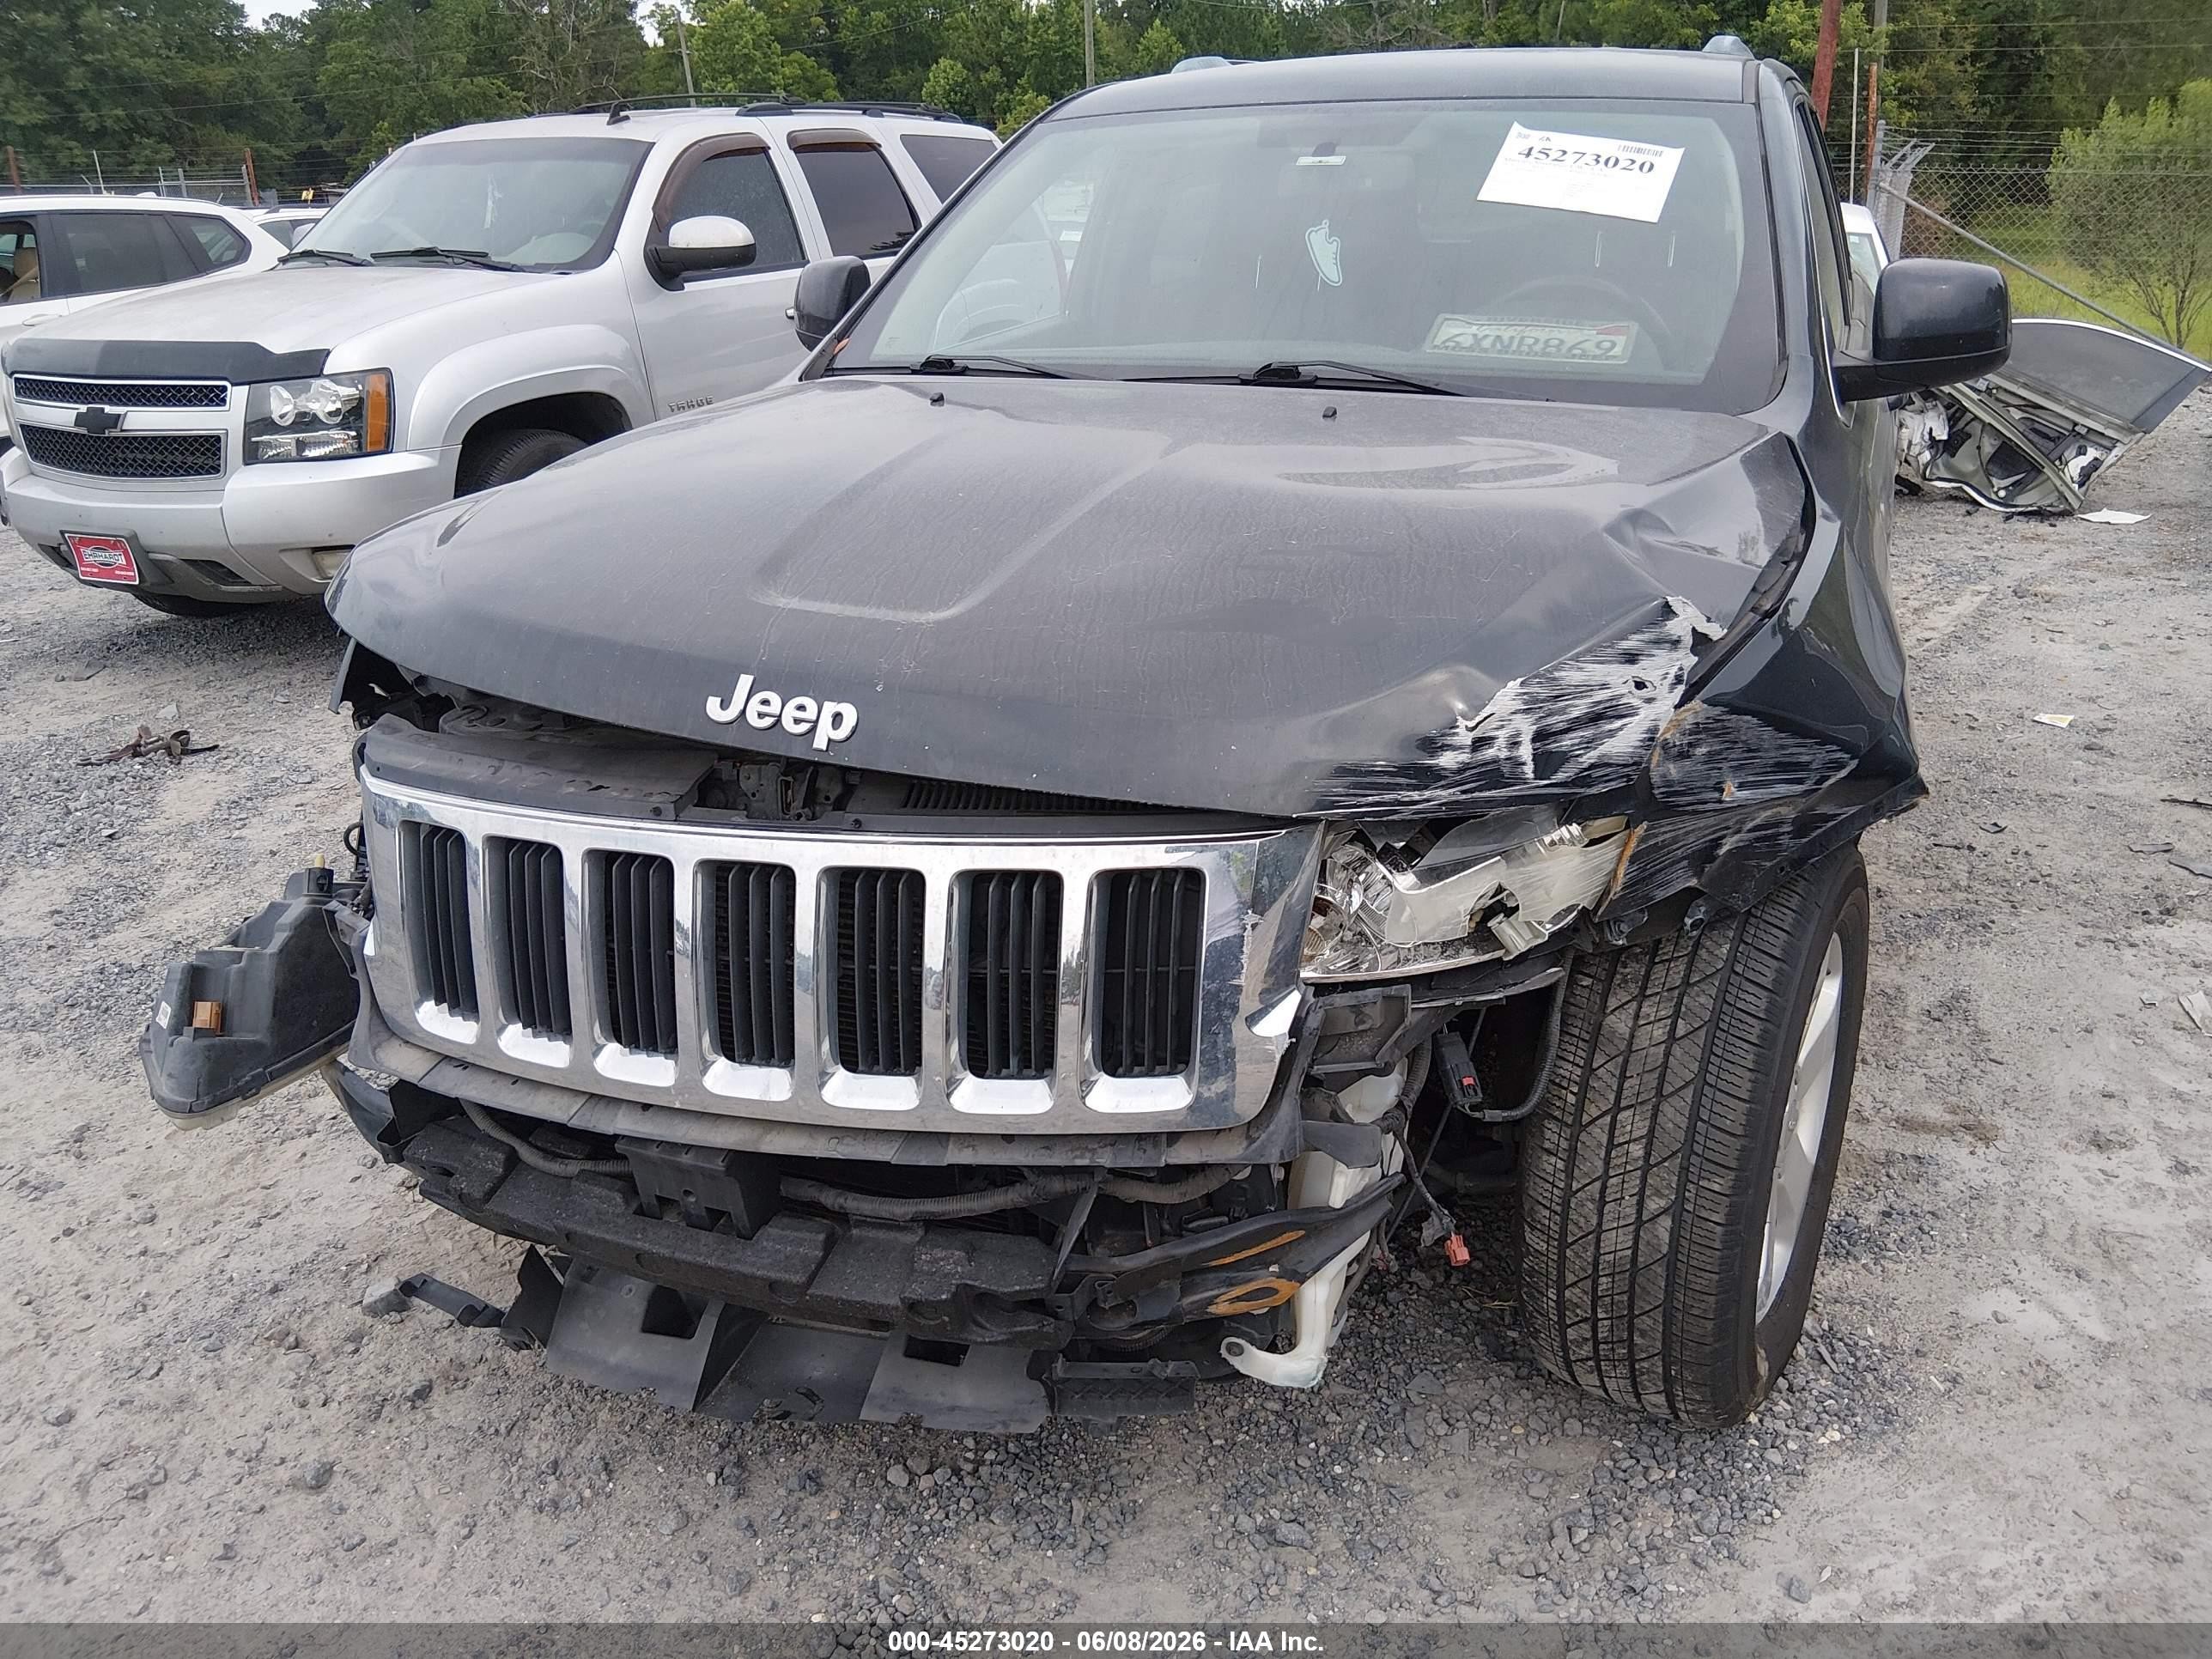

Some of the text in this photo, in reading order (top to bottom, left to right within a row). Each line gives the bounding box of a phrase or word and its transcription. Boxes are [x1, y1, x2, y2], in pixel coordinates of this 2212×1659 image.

[1517, 145, 1656, 174] 45273020
[1440, 332, 1618, 357] 6XNR869
[82, 550, 124, 562] EHRHARDT
[705, 673, 859, 752] Jeep
